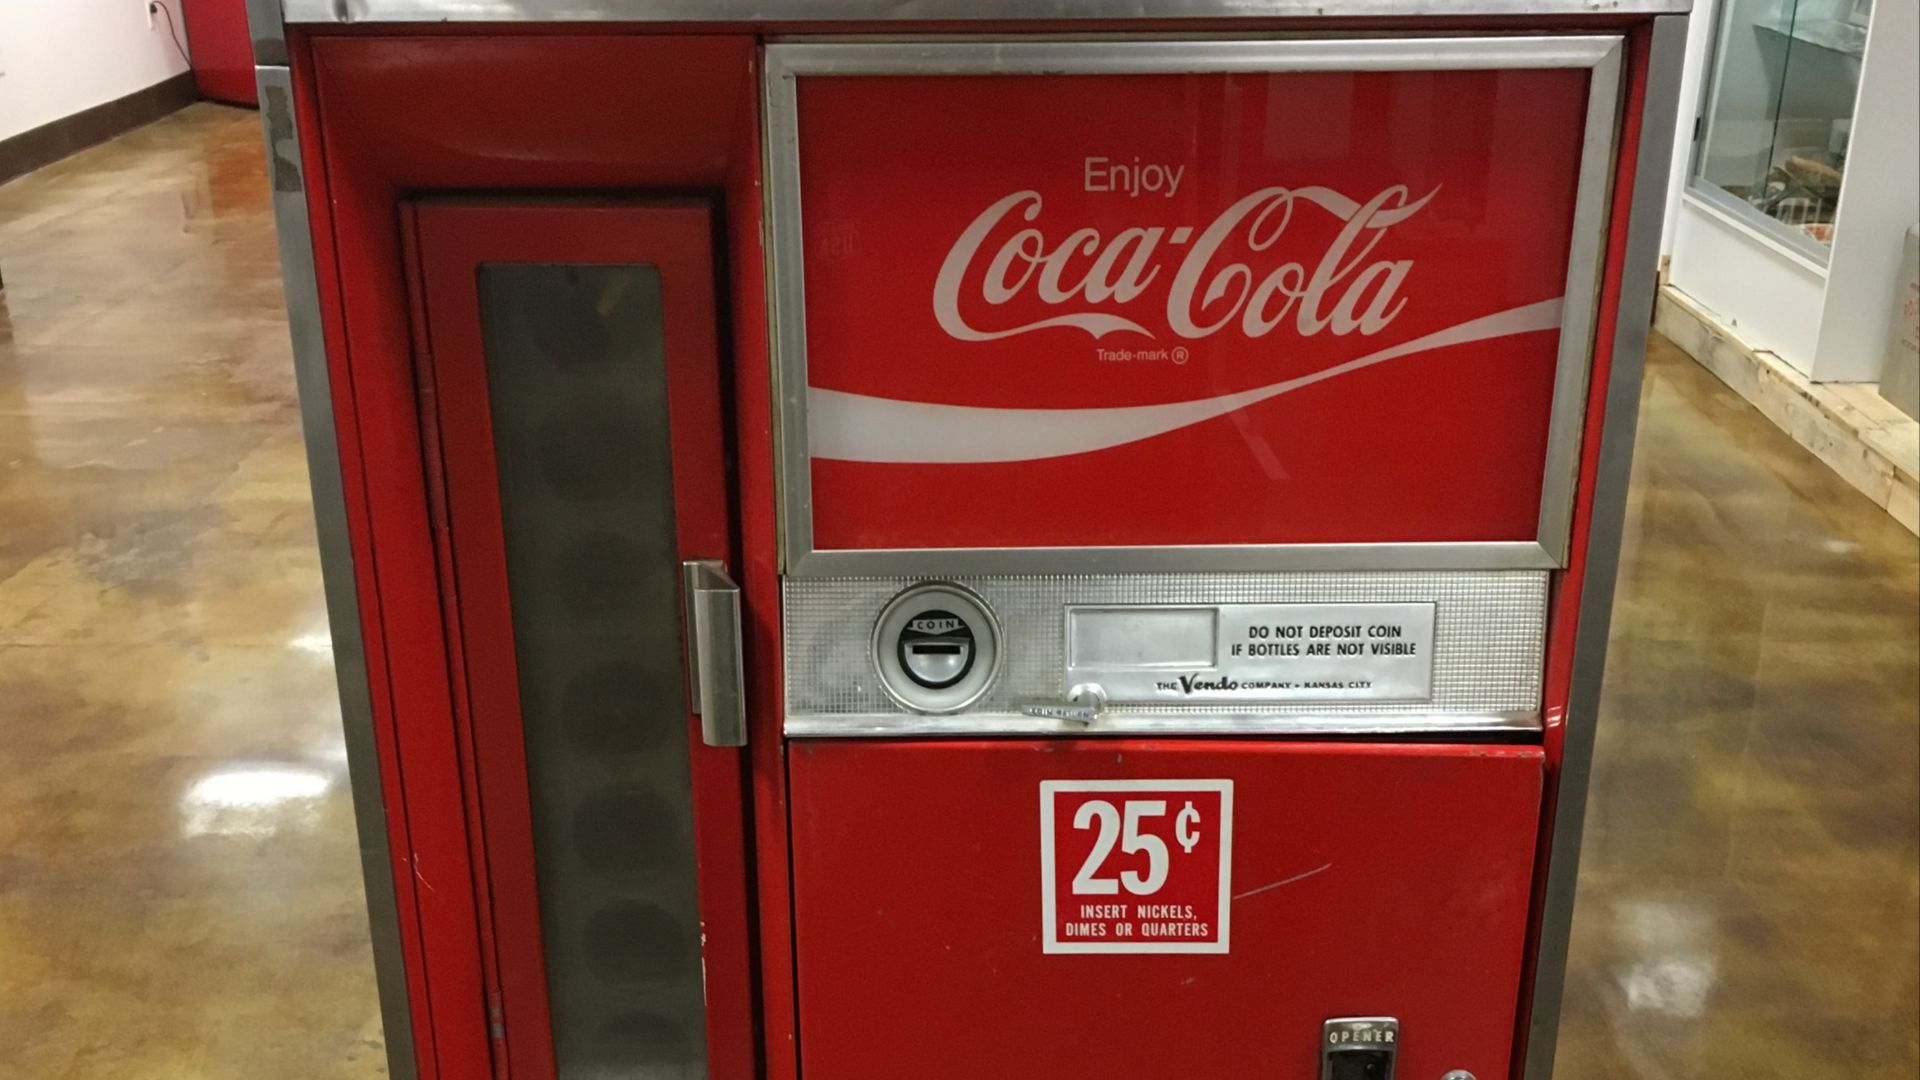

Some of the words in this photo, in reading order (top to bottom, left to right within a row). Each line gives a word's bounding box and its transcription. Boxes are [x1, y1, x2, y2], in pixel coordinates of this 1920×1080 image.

[1084, 156, 1185, 198] Enjoy
[933, 183, 1443, 342] Coca-Cola
[1096, 348, 1169, 362] Trade-mark
[917, 620, 956, 630] COIN
[1249, 626, 1269, 639] DO
[1276, 626, 1303, 639] NOT
[1309, 626, 1362, 638] DEPOSIT
[1368, 626, 1401, 638] COIN
[1231, 644, 1243, 656] IF
[1248, 644, 1300, 656] BOTTLES
[1306, 643, 1331, 656] ARE
[1337, 643, 1365, 656] NOT
[1371, 643, 1416, 655] VISIBLE
[1157, 682, 1177, 690] THE
[1178, 673, 1239, 694] Vendo
[1240, 681, 1292, 689] COMPANY
[1303, 681, 1344, 689] KANSAS
[1348, 681, 1373, 689] CITY
[1080, 904, 1128, 919] INSERT
[1137, 904, 1197, 920] NICKELS,
[1065, 922, 1106, 936] DIMES
[1115, 922, 1133, 936] OR
[1141, 922, 1208, 936] QUARTERS
[1329, 1031, 1395, 1044] OPENER
